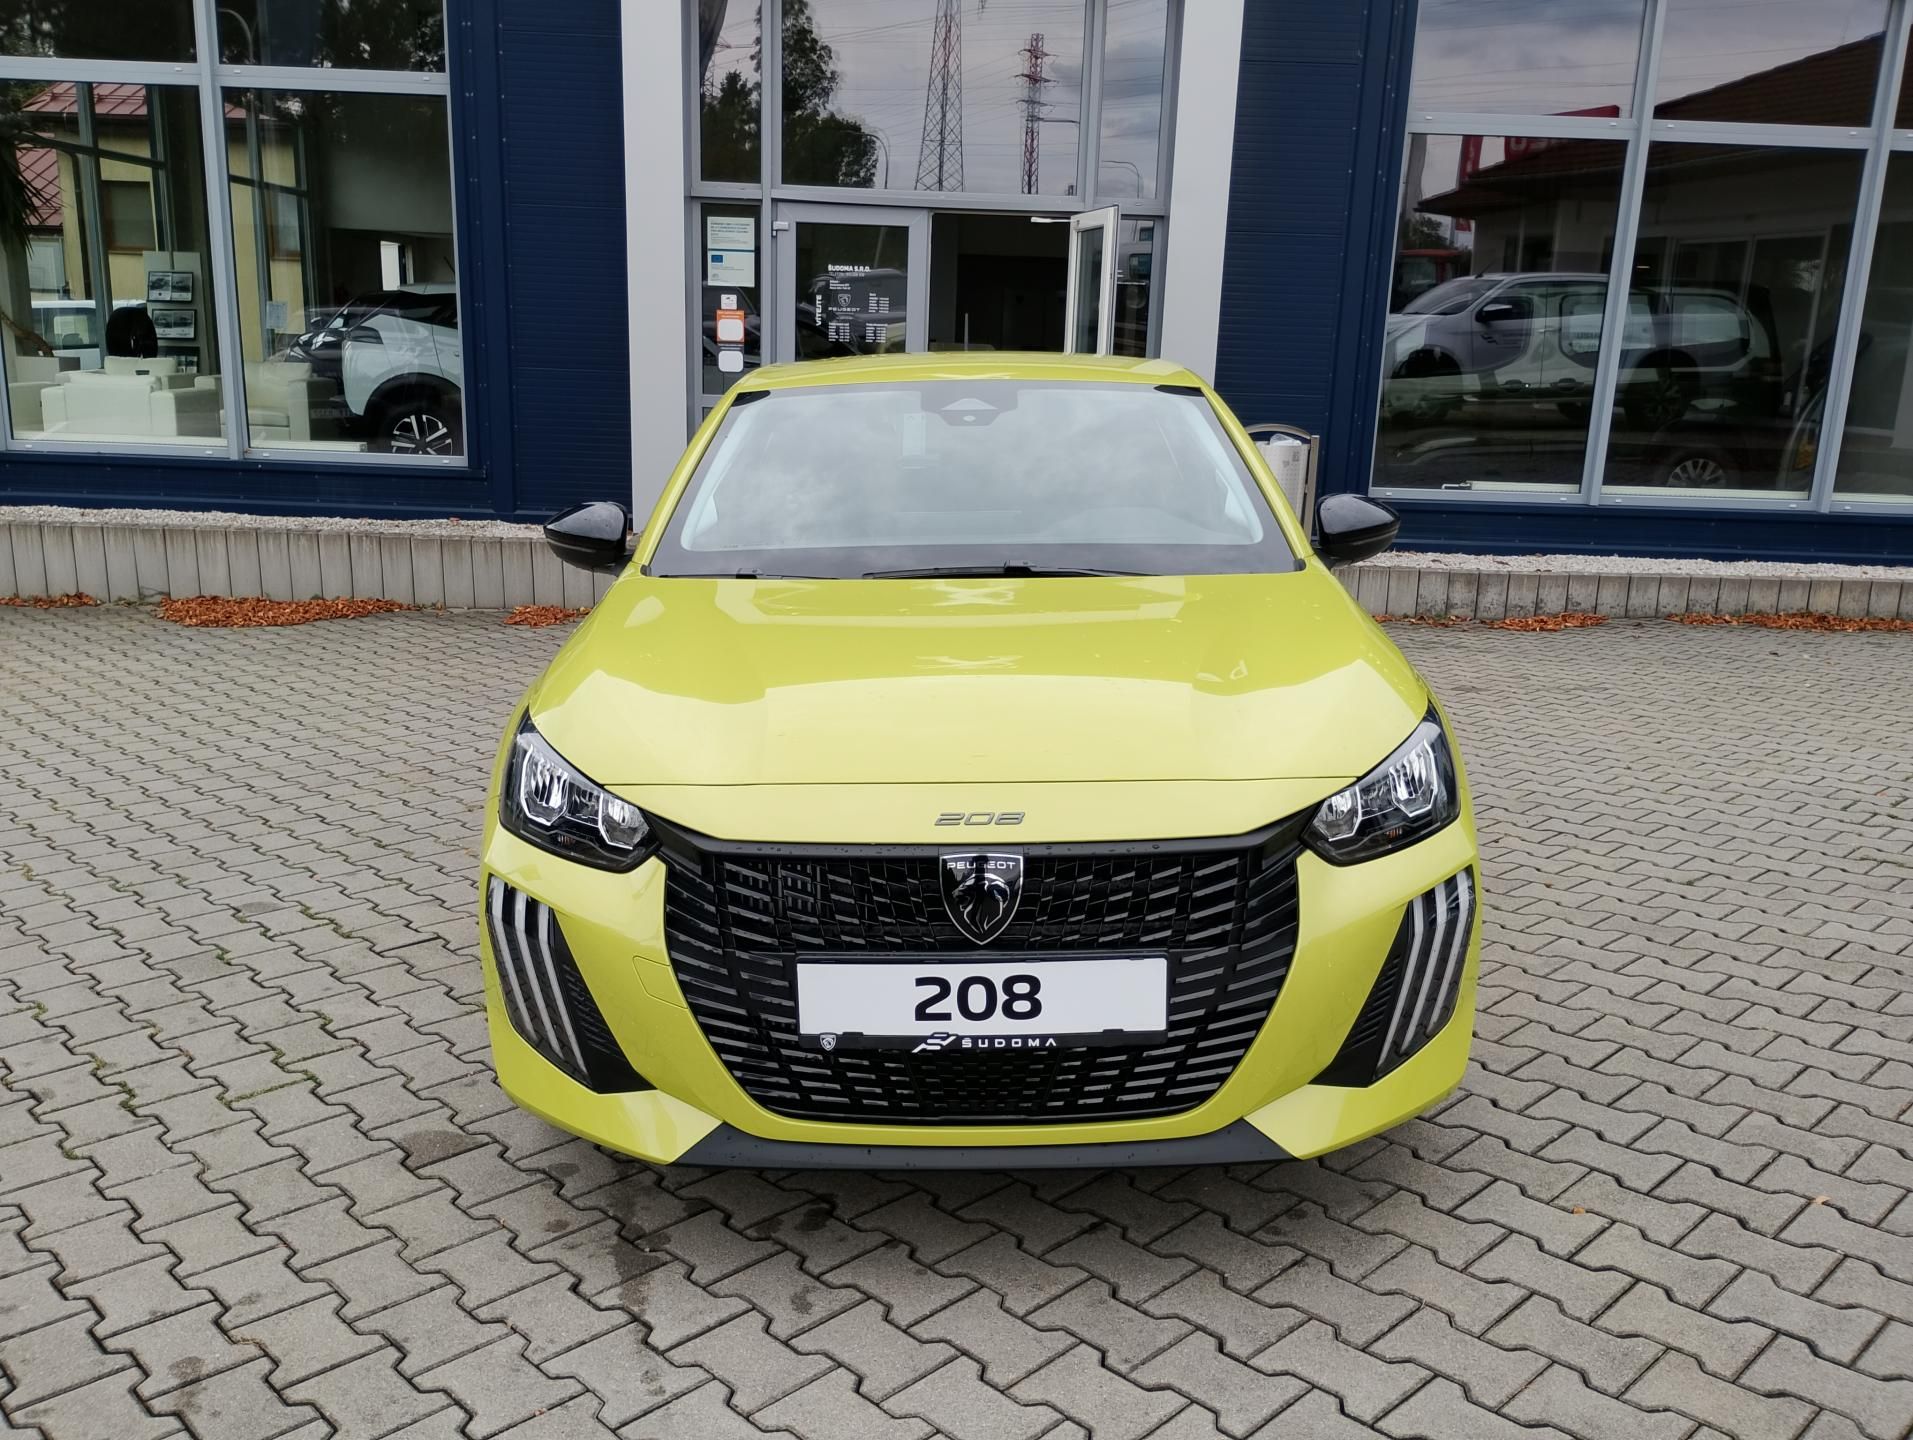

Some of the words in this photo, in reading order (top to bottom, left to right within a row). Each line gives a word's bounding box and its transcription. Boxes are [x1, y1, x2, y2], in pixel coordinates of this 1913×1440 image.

[934, 811, 1026, 826] 208
[946, 861, 1016, 870] PEUGEOT
[914, 974, 1042, 1021] 208
